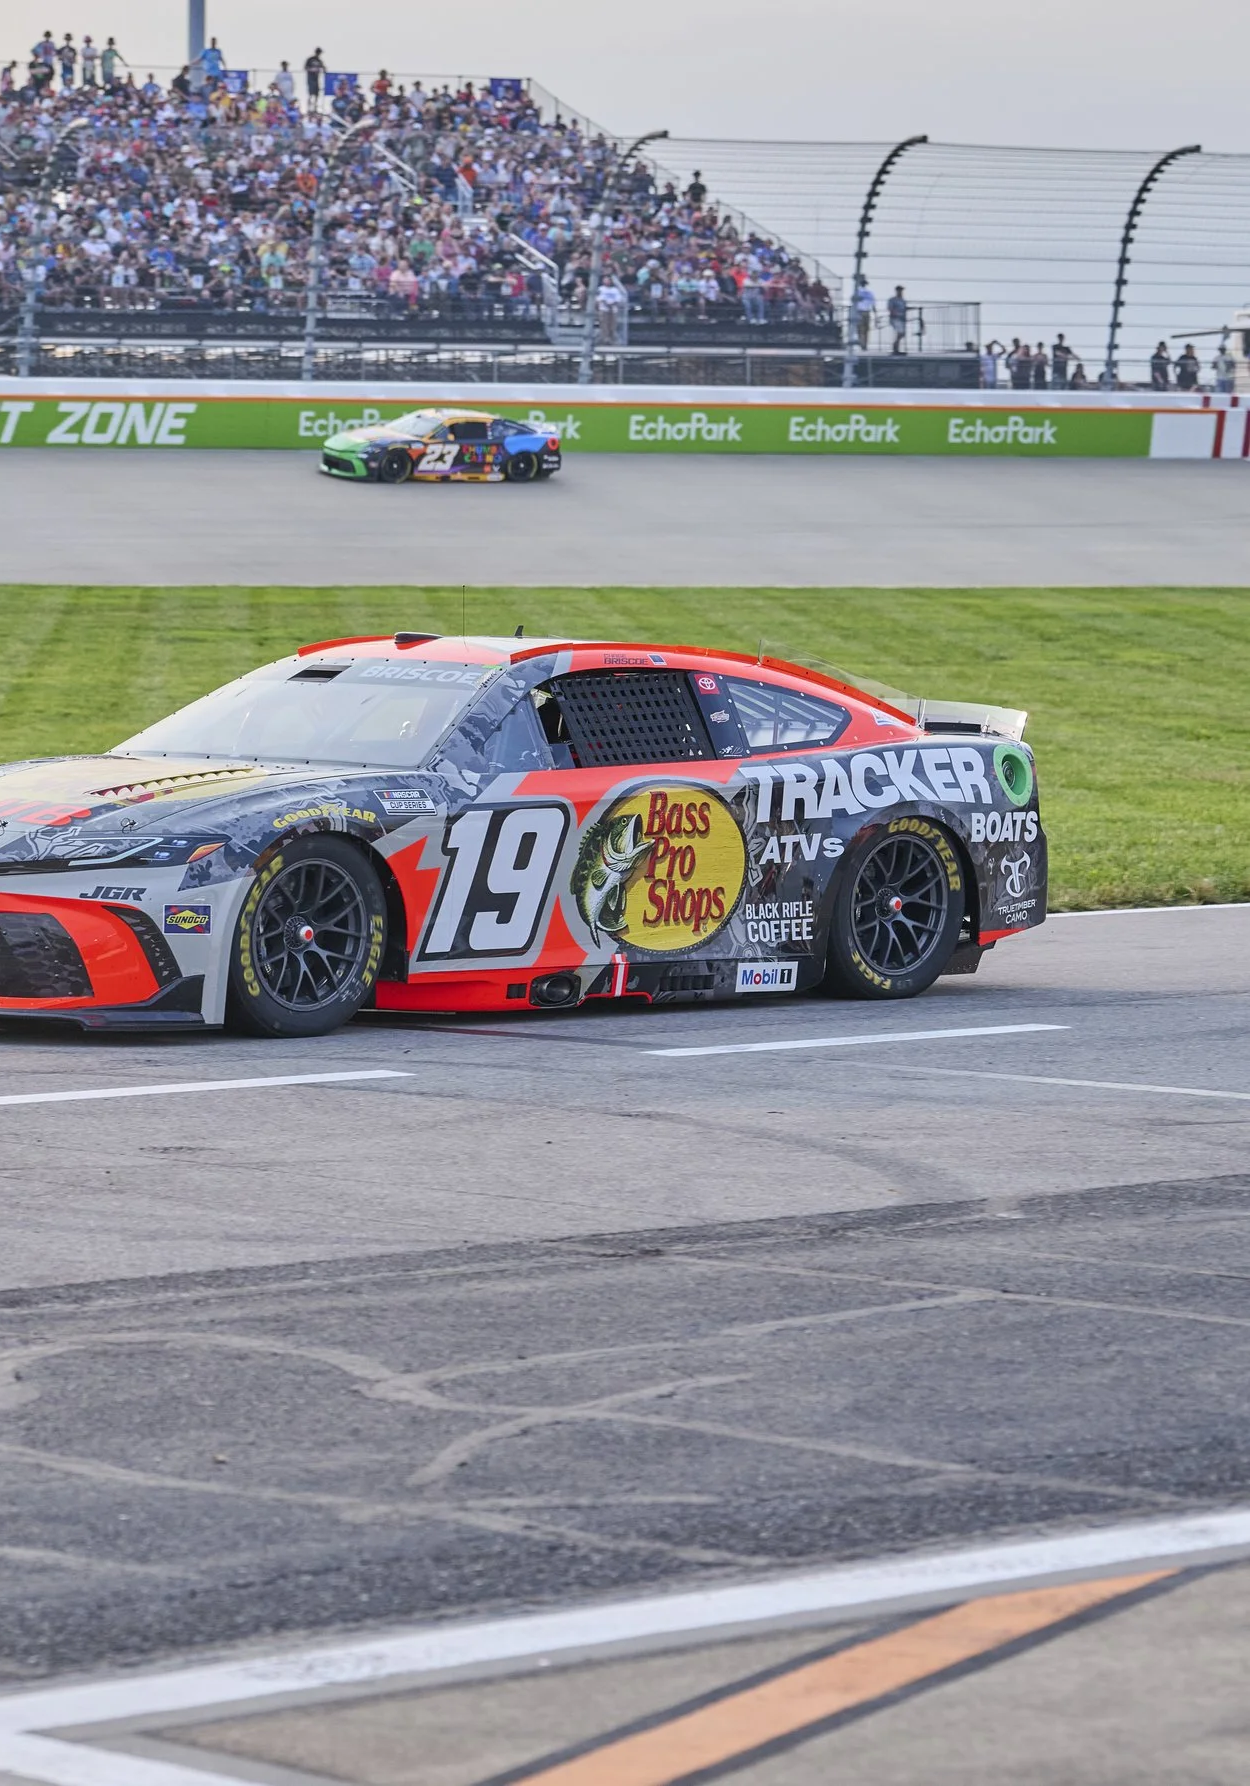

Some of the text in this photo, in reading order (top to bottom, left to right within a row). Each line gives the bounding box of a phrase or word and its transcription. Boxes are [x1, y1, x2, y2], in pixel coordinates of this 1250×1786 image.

[46, 402, 197, 445] ZONE
[629, 412, 742, 442] EchoPark
[789, 413, 900, 443] EchoPark
[948, 415, 1057, 445] EchoPark
[418, 443, 460, 471] 23
[359, 665, 482, 685] BRISCOE
[604, 657, 648, 665] BRISCOE
[392, 791, 420, 799] NASCAR
[738, 747, 993, 823] TRACKER
[273, 803, 376, 828] GOODYEAR
[390, 801, 427, 809] CUP SERIES
[644, 791, 710, 837] Bass
[971, 811, 1038, 842] BOATS
[645, 836, 696, 881] Pro
[759, 833, 845, 865] ATVs
[888, 818, 961, 891] GOODYEAR
[79, 886, 147, 901] JGR
[425, 807, 565, 954] 19
[168, 915, 207, 924] SUNOCO
[643, 878, 725, 935] Shops
[746, 901, 813, 920] BLACK RIFLE
[998, 899, 1036, 915] TRUETIMBER
[1005, 911, 1028, 924] CAMO
[747, 918, 814, 943] COFFEE
[362, 914, 383, 988] EAGLE
[741, 968, 792, 985] Mobil 1
